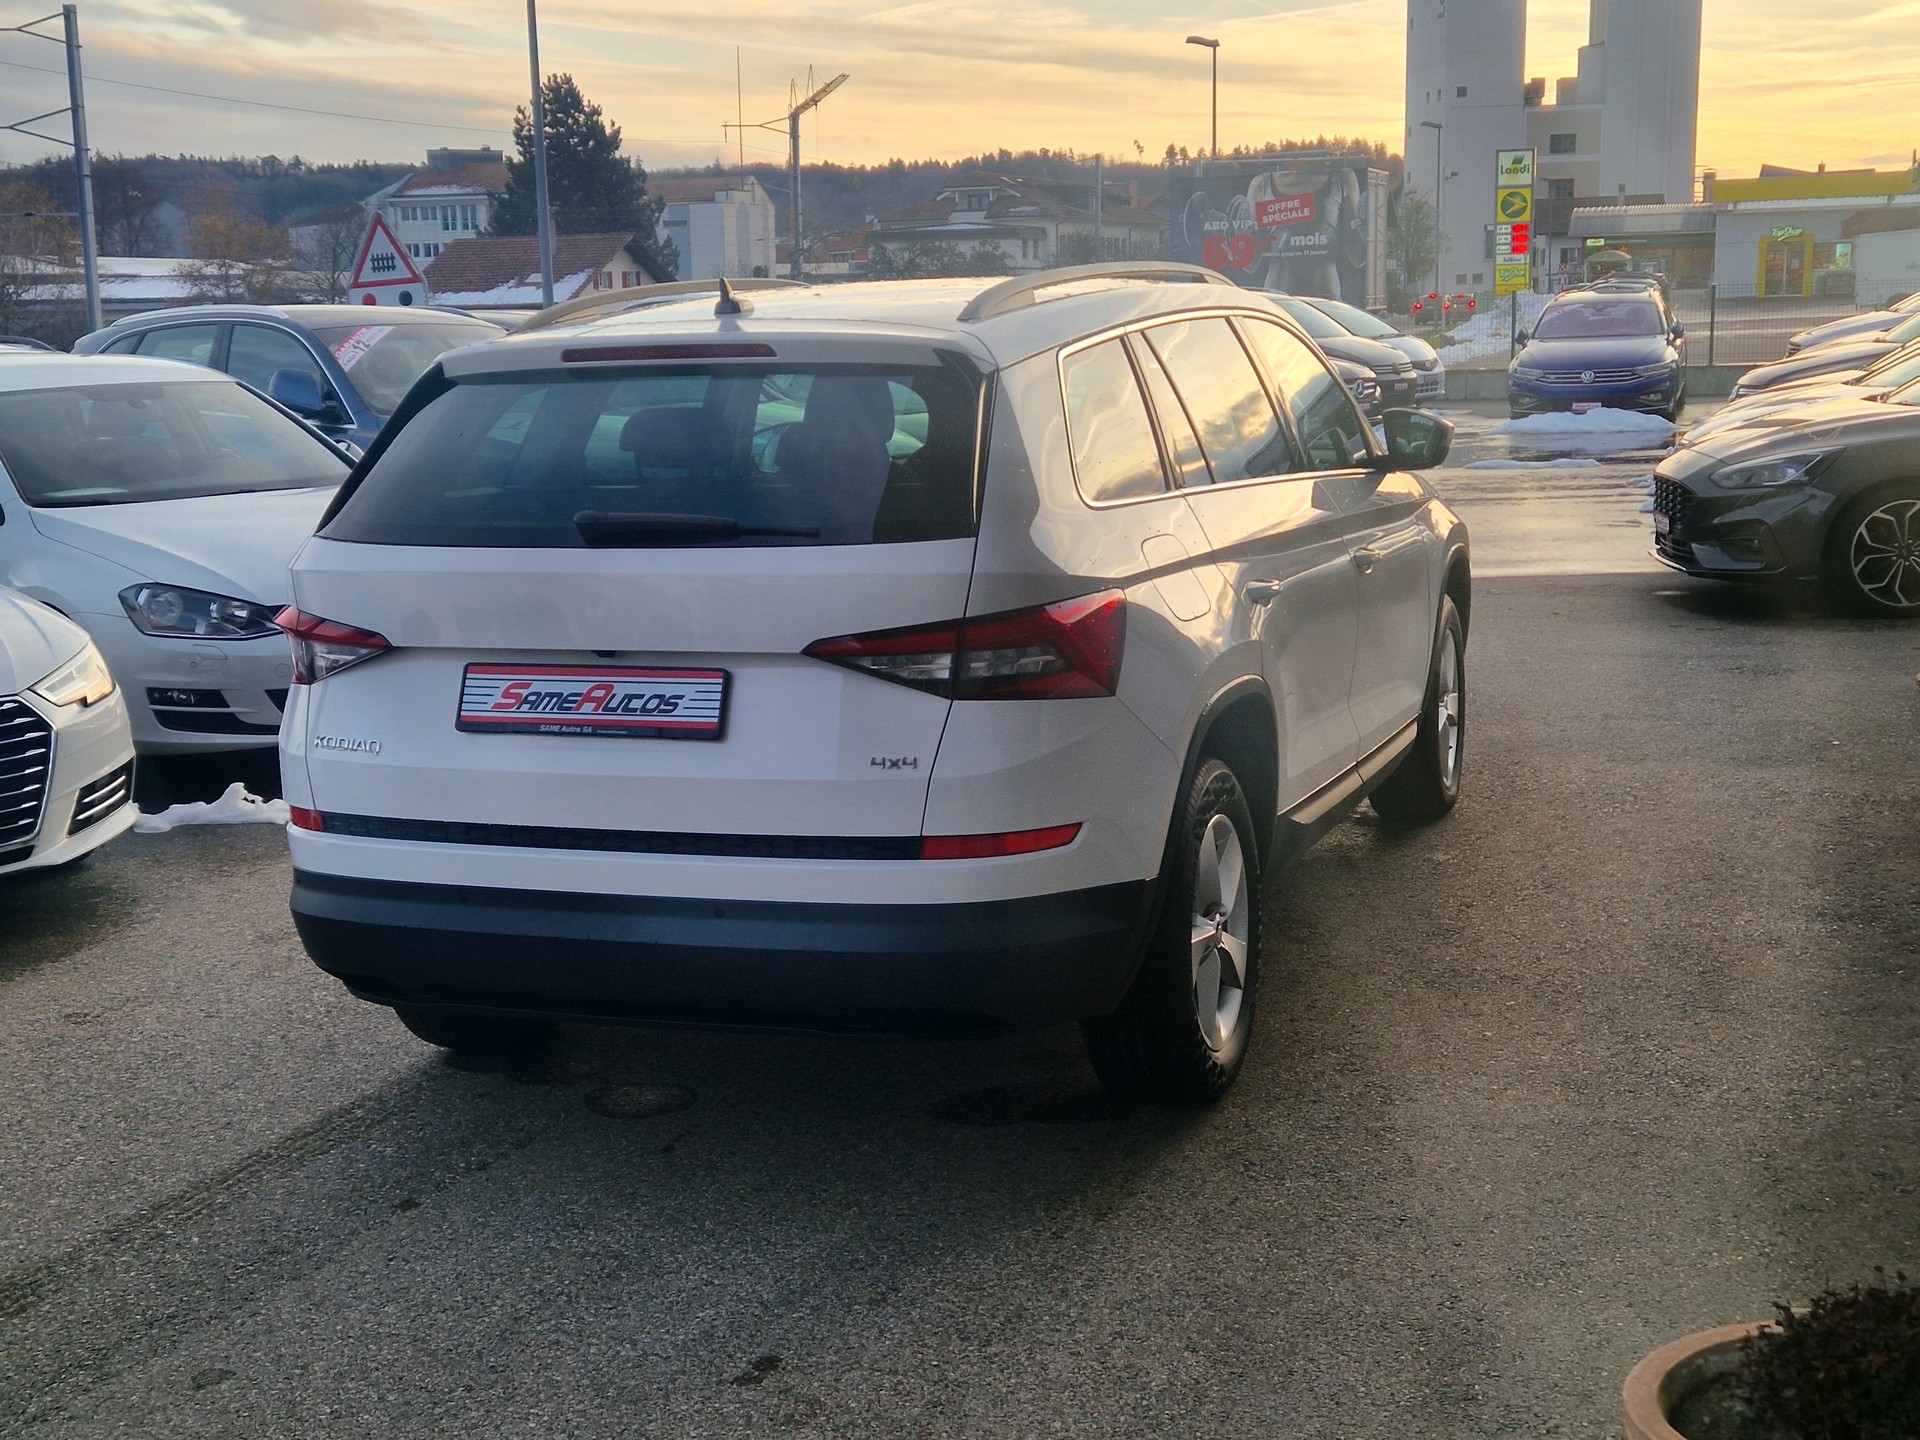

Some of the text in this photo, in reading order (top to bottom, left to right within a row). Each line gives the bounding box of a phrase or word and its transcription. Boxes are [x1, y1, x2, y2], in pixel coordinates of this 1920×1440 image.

[1500, 164, 1530, 175] Landi
[1267, 199, 1300, 212] OFFRE
[1262, 208, 1310, 224] SPÉCIALE
[1203, 220, 1252, 231] ABO VIP
[1290, 231, 1328, 246] mois
[1771, 226, 1803, 241] TopShop
[352, 340, 372, 352] 12
[539, 724, 561, 732] SAME
[561, 725, 580, 733] Autos
[582, 725, 592, 733] SA
[314, 735, 381, 756] KODIAQ
